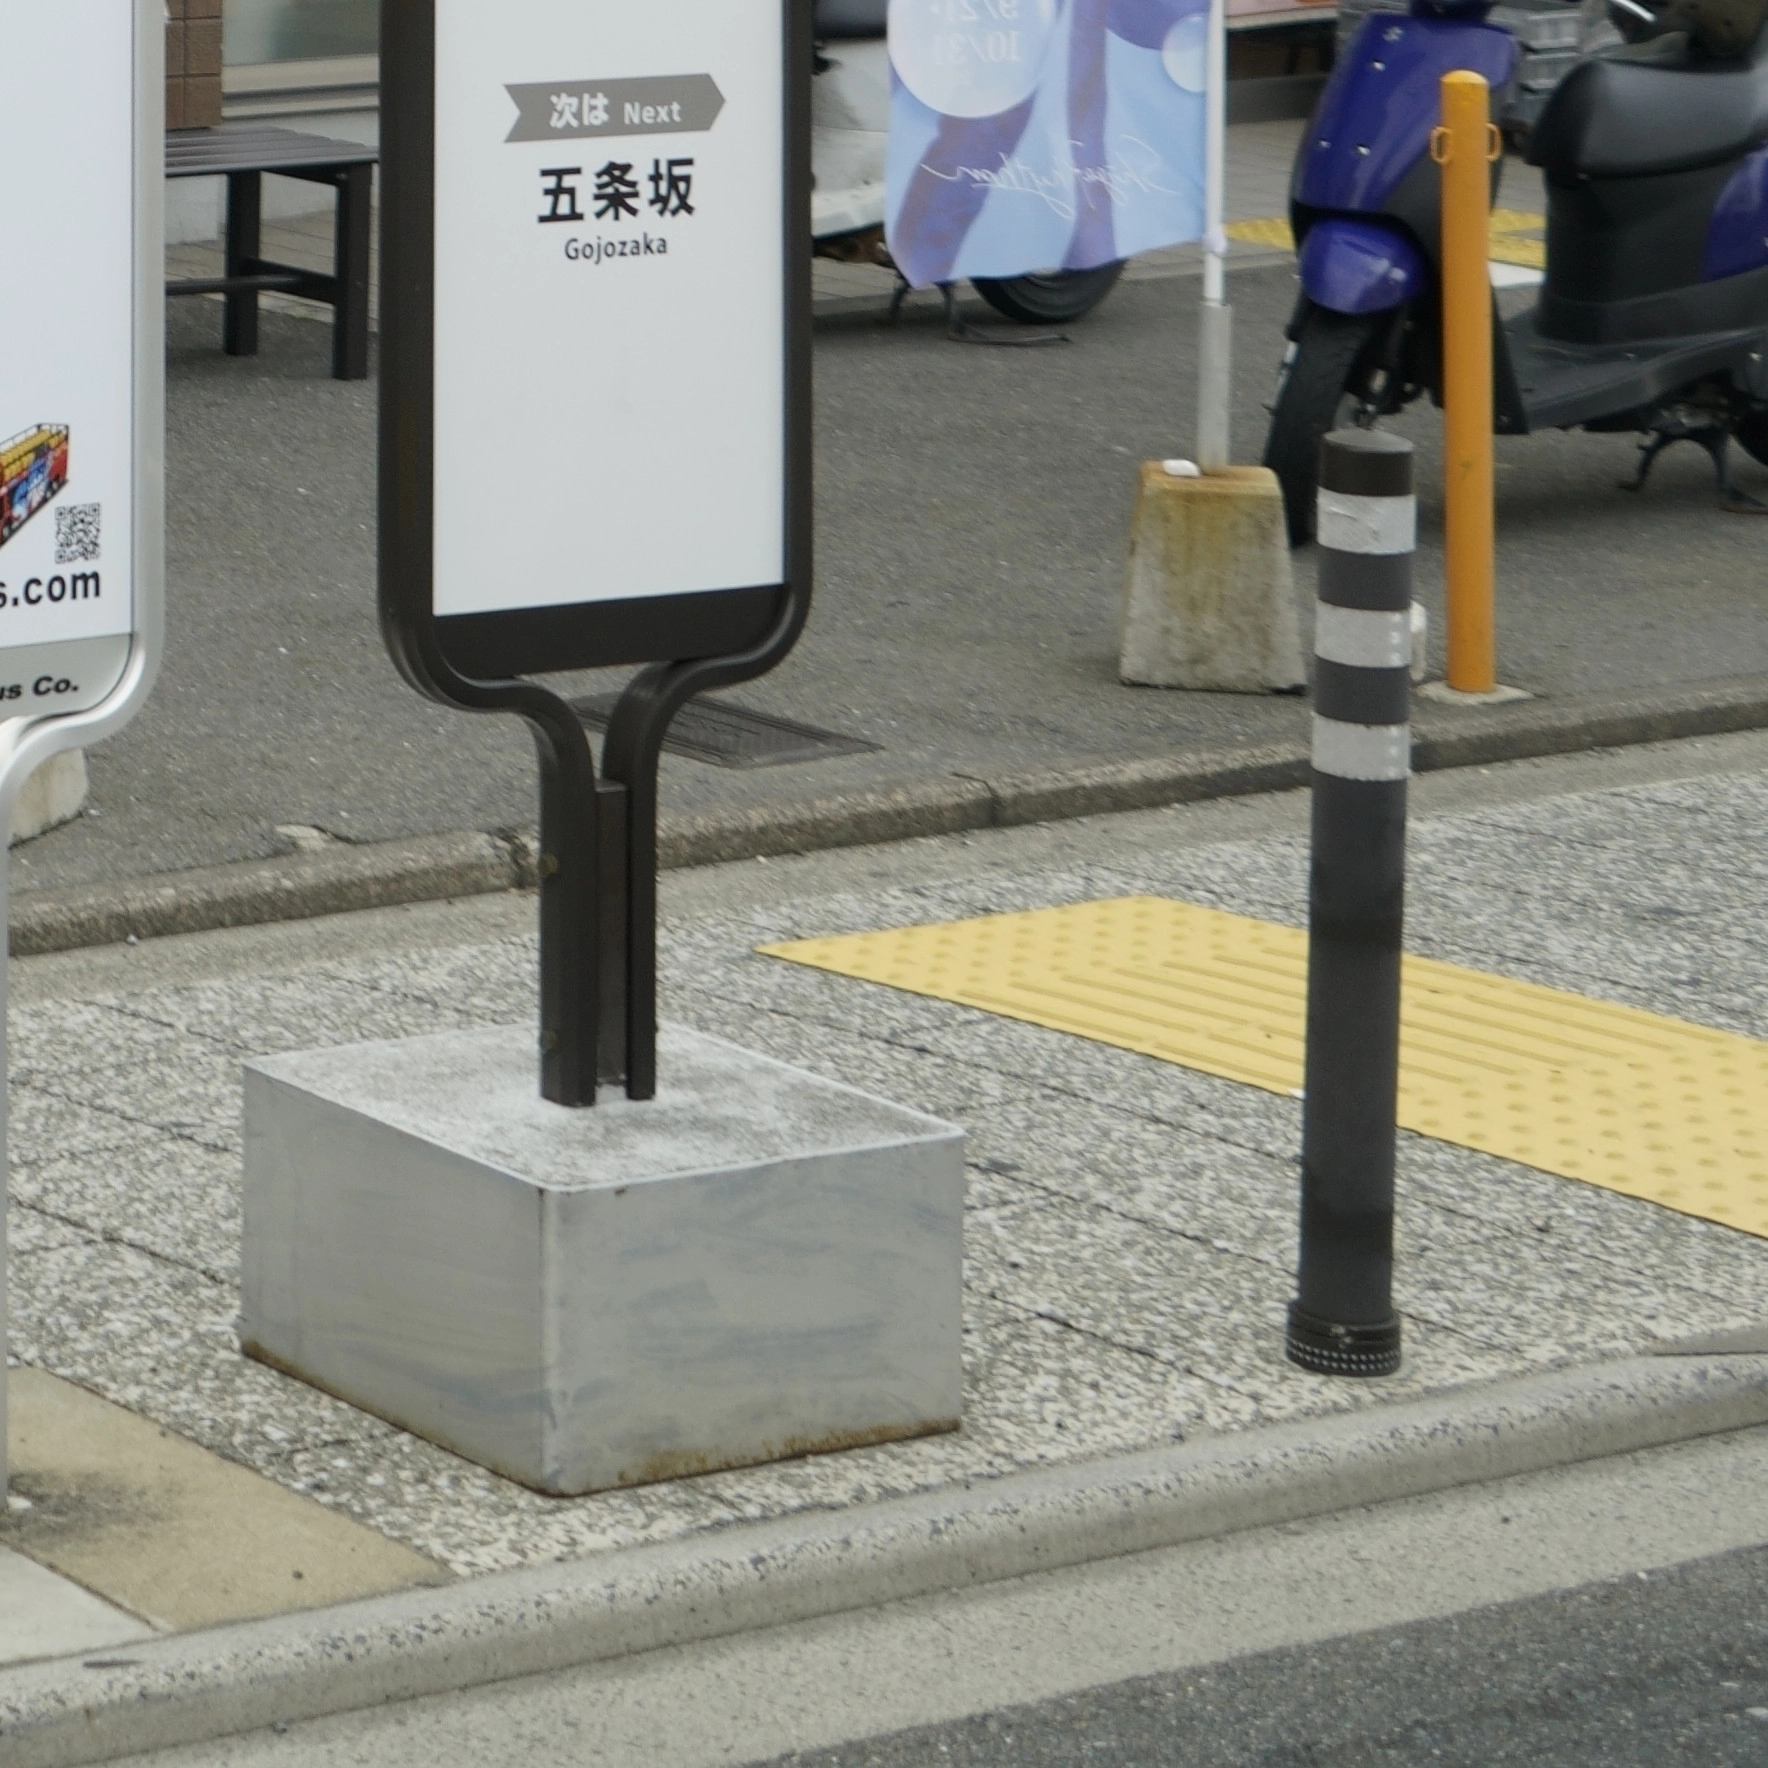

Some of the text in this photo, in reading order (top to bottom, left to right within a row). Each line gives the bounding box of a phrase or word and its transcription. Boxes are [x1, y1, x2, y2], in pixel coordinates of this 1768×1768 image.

[549, 92, 683, 128] 次は Next
[537, 158, 695, 224] 五条坂
[564, 232, 668, 265] Gojozaka
[32, 674, 80, 696] Co.
